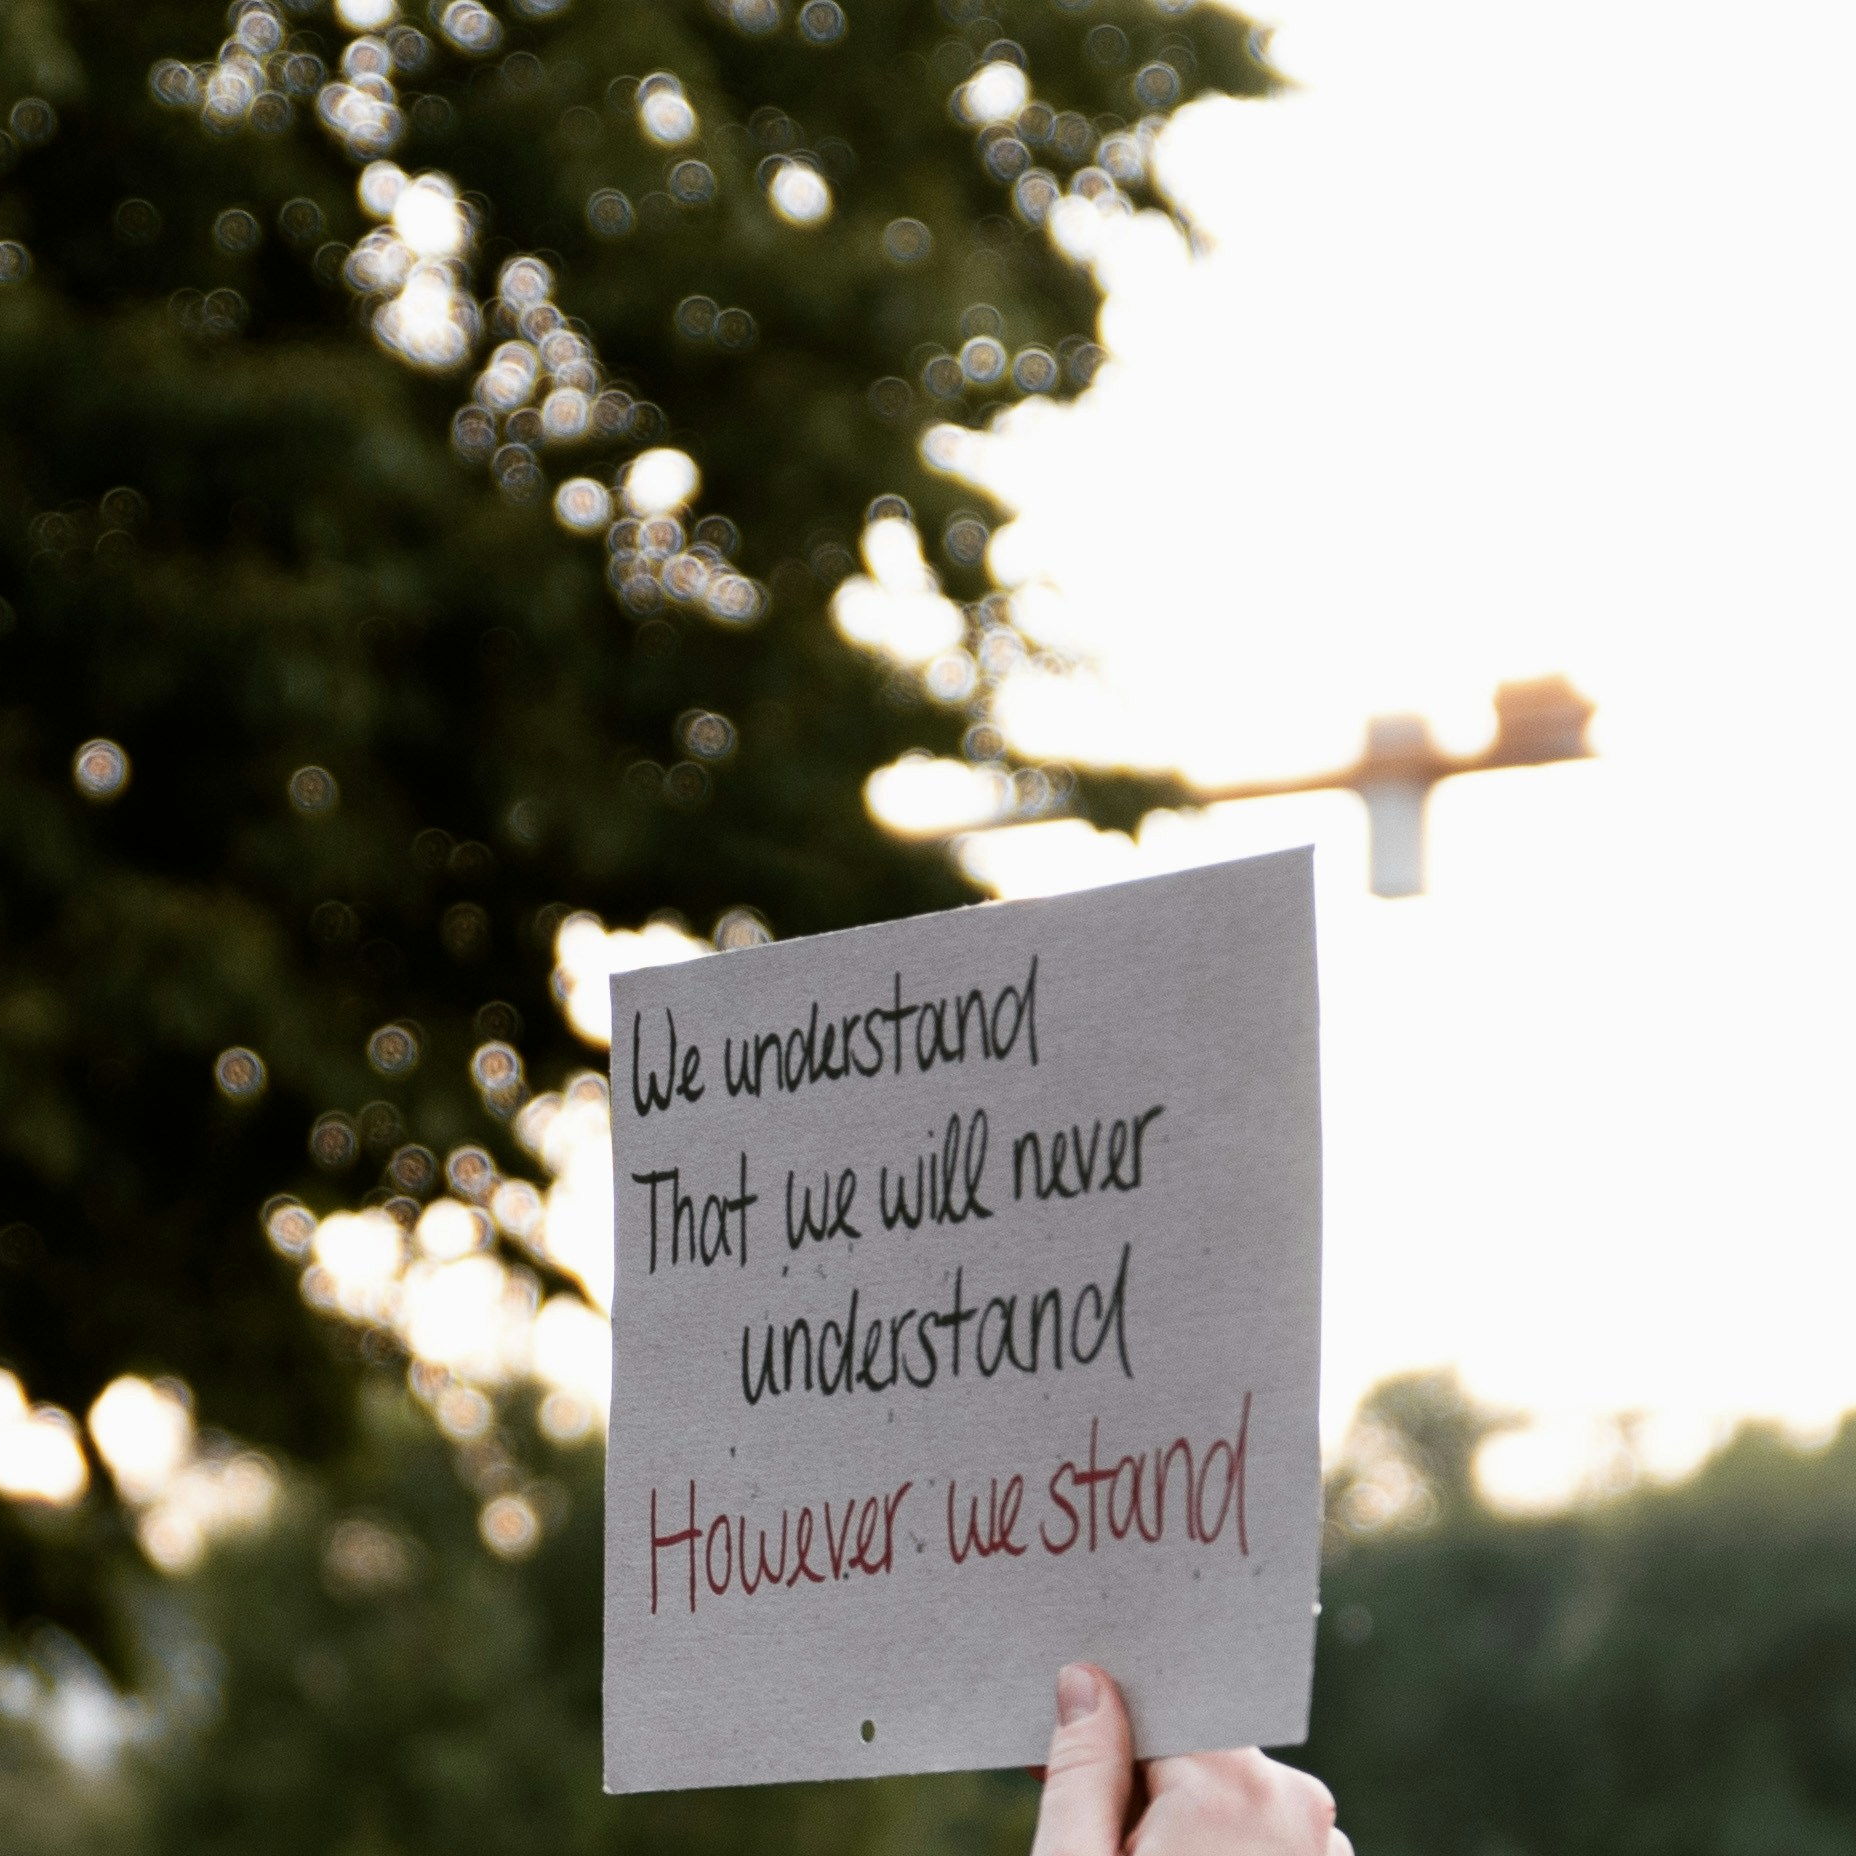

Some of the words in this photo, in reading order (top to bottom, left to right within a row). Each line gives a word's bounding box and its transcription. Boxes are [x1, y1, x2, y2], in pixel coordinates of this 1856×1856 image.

[631, 1007, 706, 1117] We
[724, 953, 1042, 1099] understand
[631, 1151, 758, 1275] That
[784, 1166, 862, 1241] we
[878, 1108, 993, 1230] will
[1012, 1105, 1167, 1202] never
[742, 1241, 1135, 1405] understand
[650, 1478, 912, 1615] However
[946, 1474, 1027, 1564] we
[1040, 1391, 1253, 1557] stand
